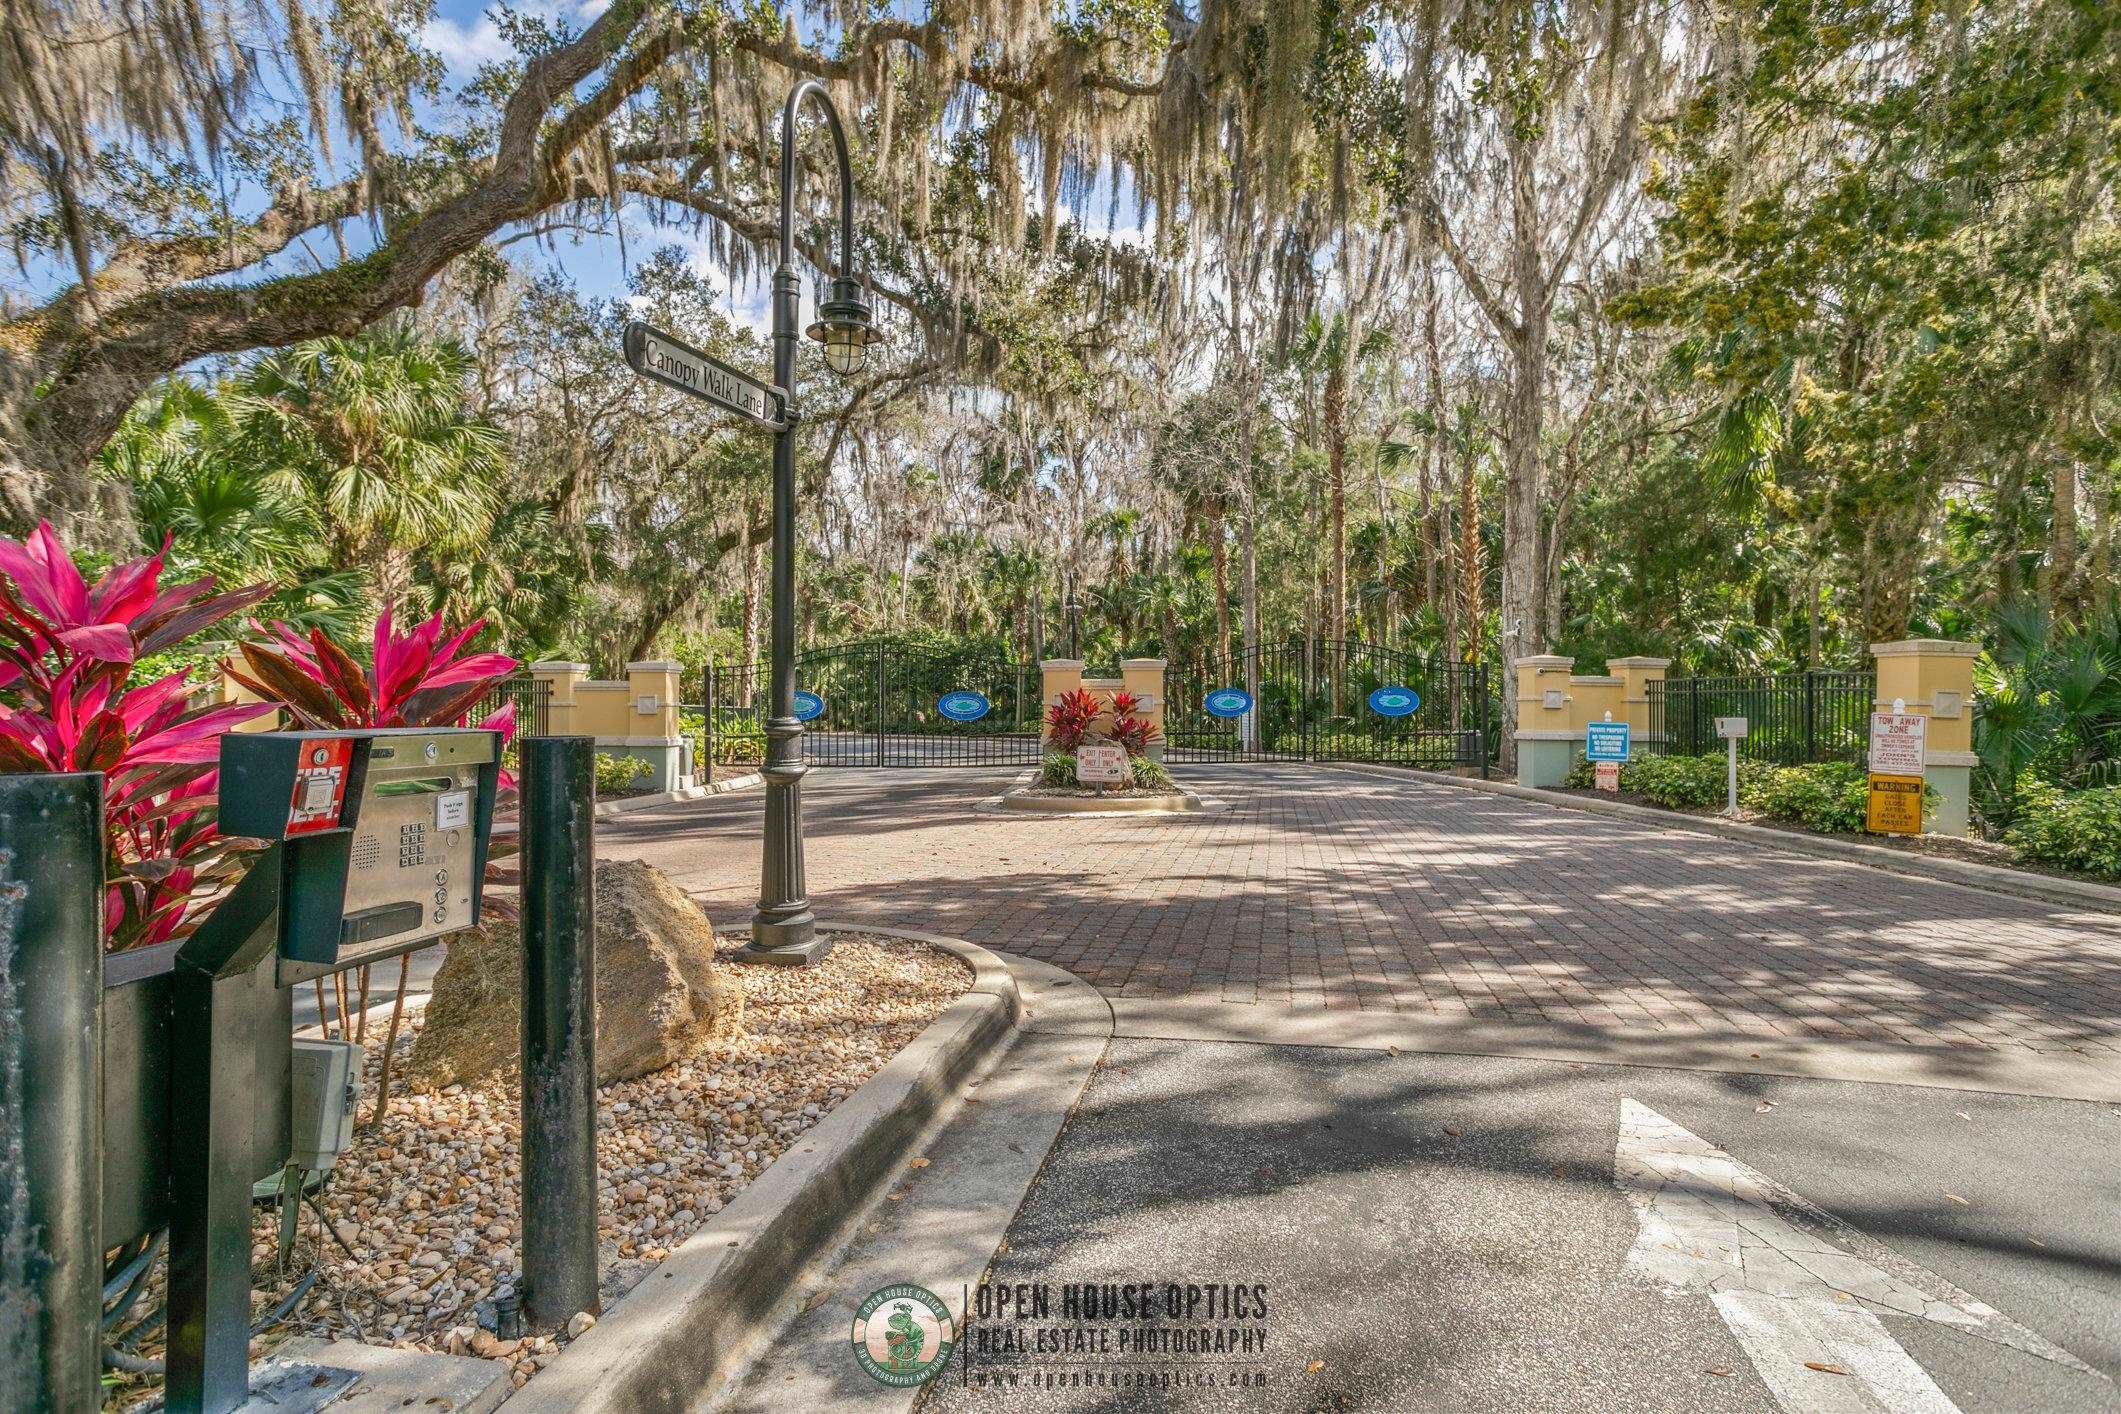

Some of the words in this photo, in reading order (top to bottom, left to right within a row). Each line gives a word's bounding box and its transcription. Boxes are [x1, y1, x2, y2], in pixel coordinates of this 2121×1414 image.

[645, 339, 701, 388] Canopy
[702, 365, 734, 402] Walk
[736, 382, 763, 415] Lane
[1878, 716, 1893, 725] TOW
[1899, 717, 1920, 726] AWAY
[1889, 725, 1909, 734] ZONE
[1086, 749, 1096, 757] EXIT
[1877, 782, 1917, 792] WARNING
